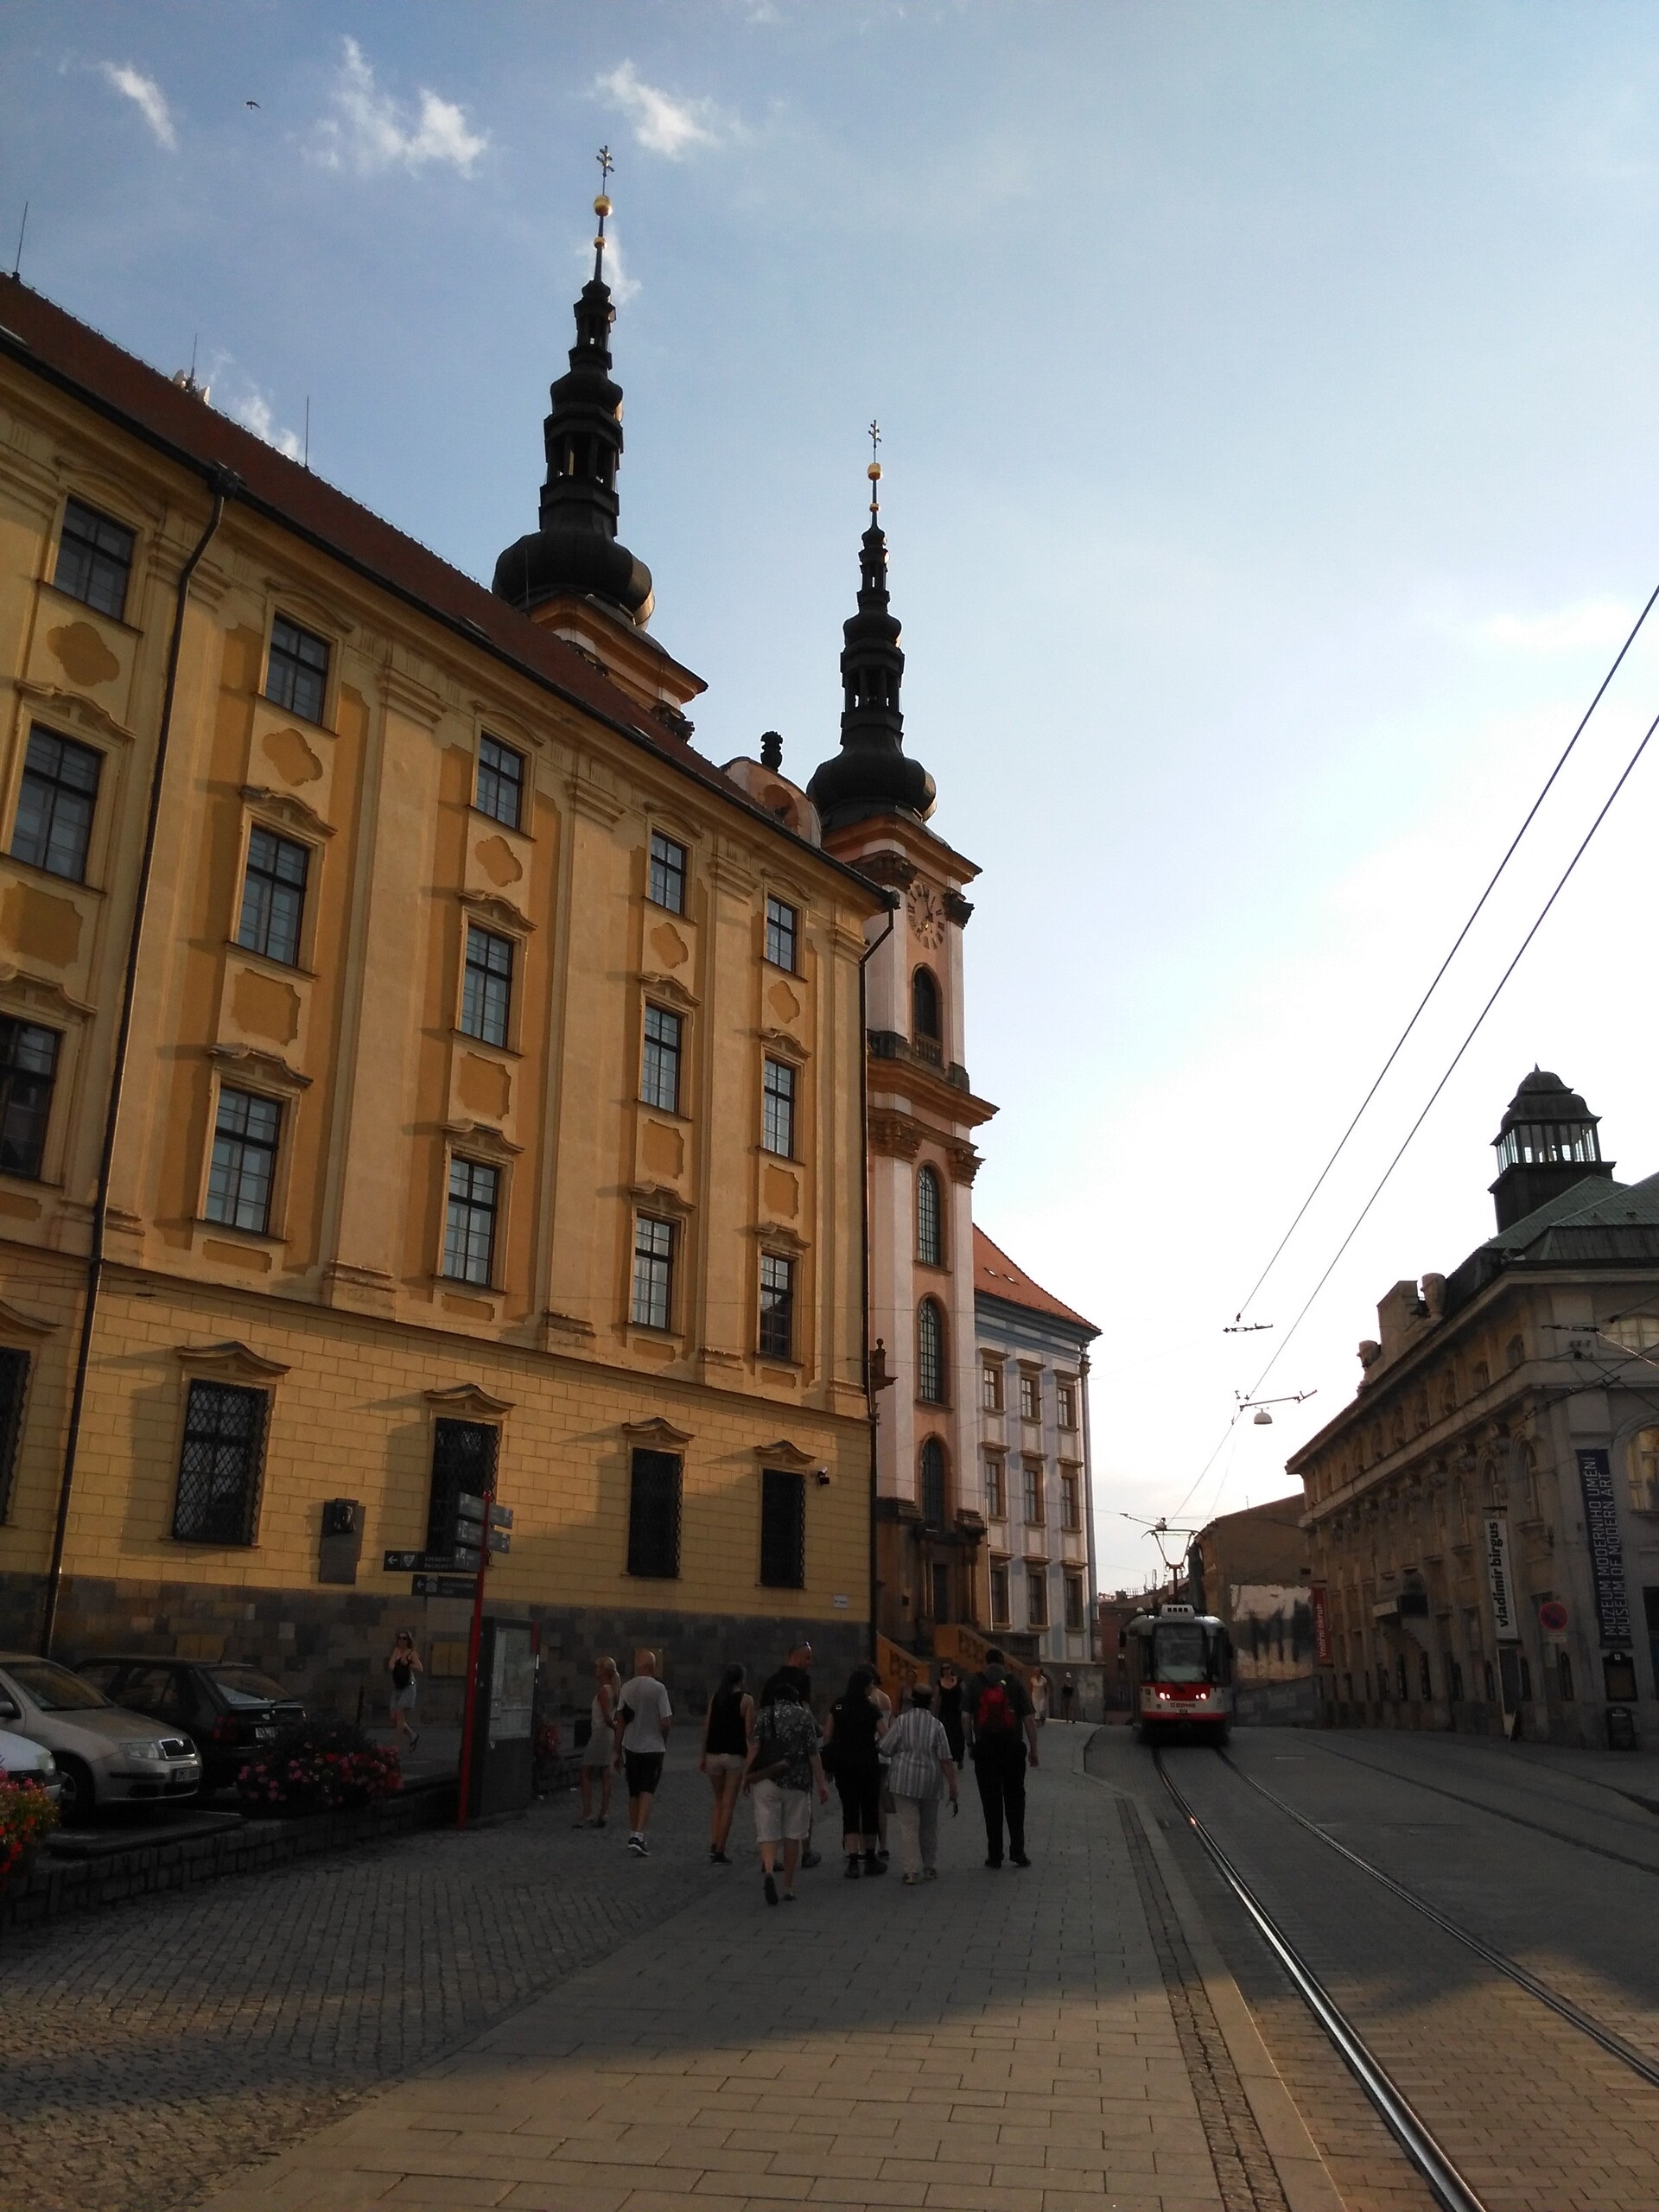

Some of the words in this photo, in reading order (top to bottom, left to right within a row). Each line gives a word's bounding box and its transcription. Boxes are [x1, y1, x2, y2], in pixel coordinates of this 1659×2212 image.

[1581, 1457, 1600, 1497] UMĚNÍ
[1598, 1471, 1613, 1497] ART
[1489, 1522, 1503, 1567] birgus
[1588, 1501, 1611, 1577] MODERNÍHO
[1604, 1501, 1622, 1555] MODERN
[1610, 1556, 1624, 1576] OF
[1316, 1604, 1325, 1629] okruh
[1599, 1580, 1618, 1637] MUZEUM
[1612, 1580, 1631, 1637] MUSEUM
